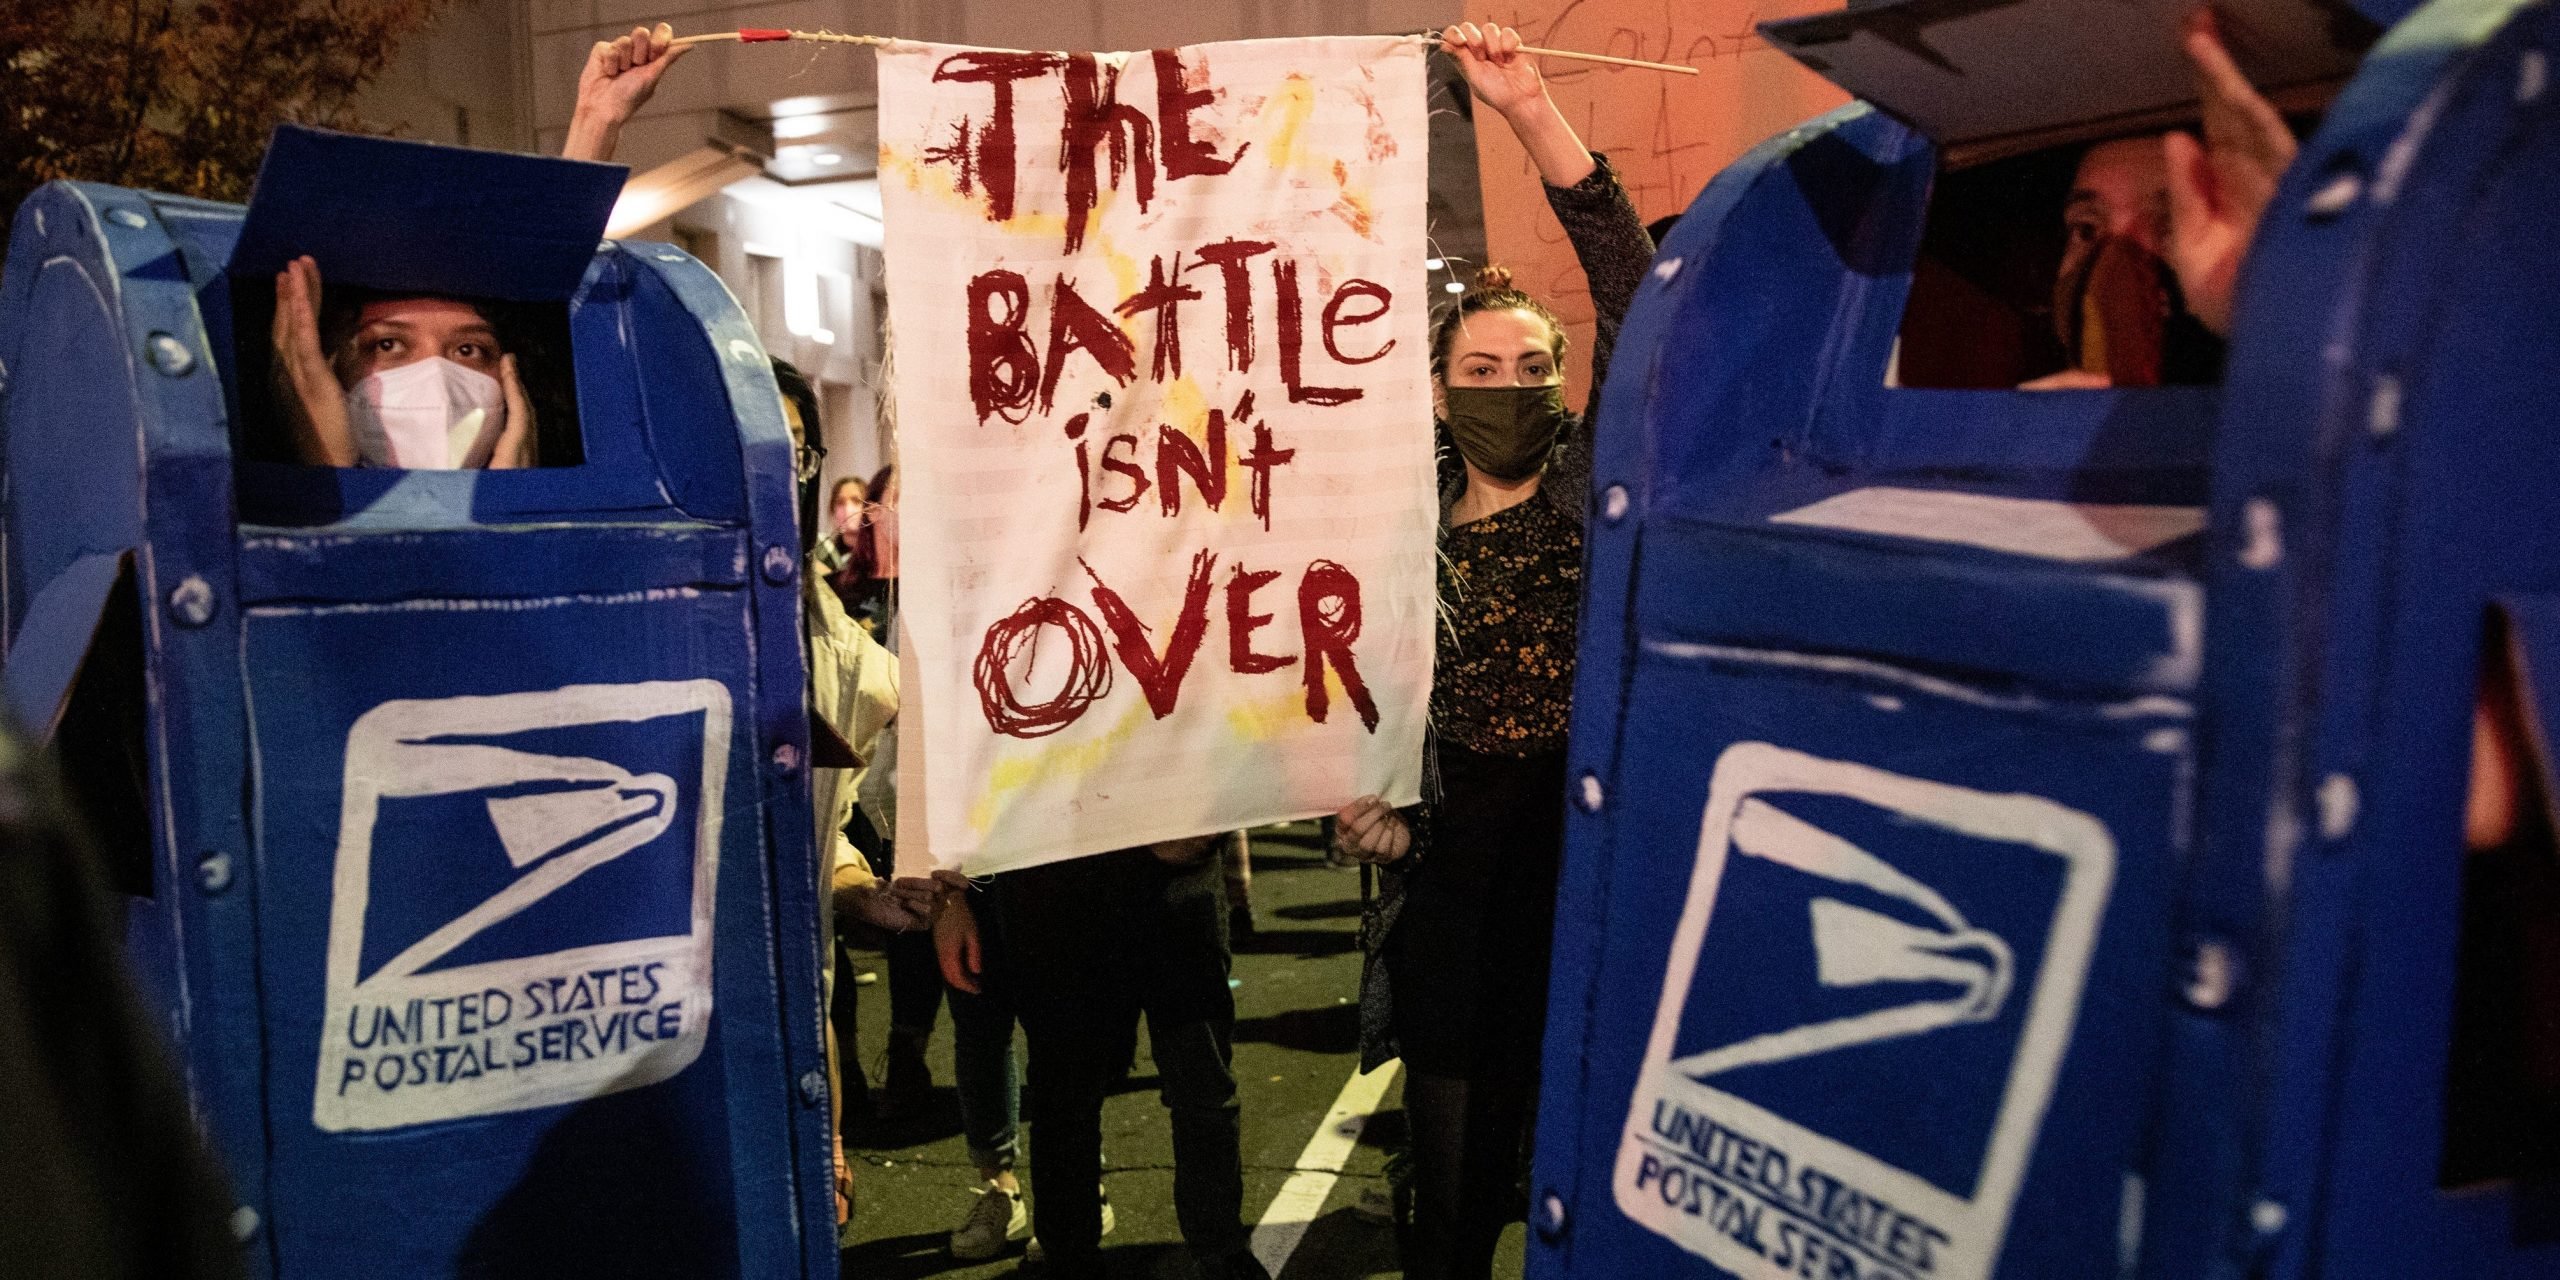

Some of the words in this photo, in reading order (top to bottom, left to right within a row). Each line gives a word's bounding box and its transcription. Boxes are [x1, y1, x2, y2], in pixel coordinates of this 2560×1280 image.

[973, 548, 1380, 740] OVER
[338, 1037, 504, 1097] POSTAL
[510, 1002, 682, 1071] SERVICE
[347, 988, 512, 1050] UNITED
[525, 961, 665, 1020] STATES
[1636, 1153, 1769, 1258] POSTAL
[1651, 1098, 1791, 1196] UNITED
[1798, 1167, 1952, 1271] STATES
